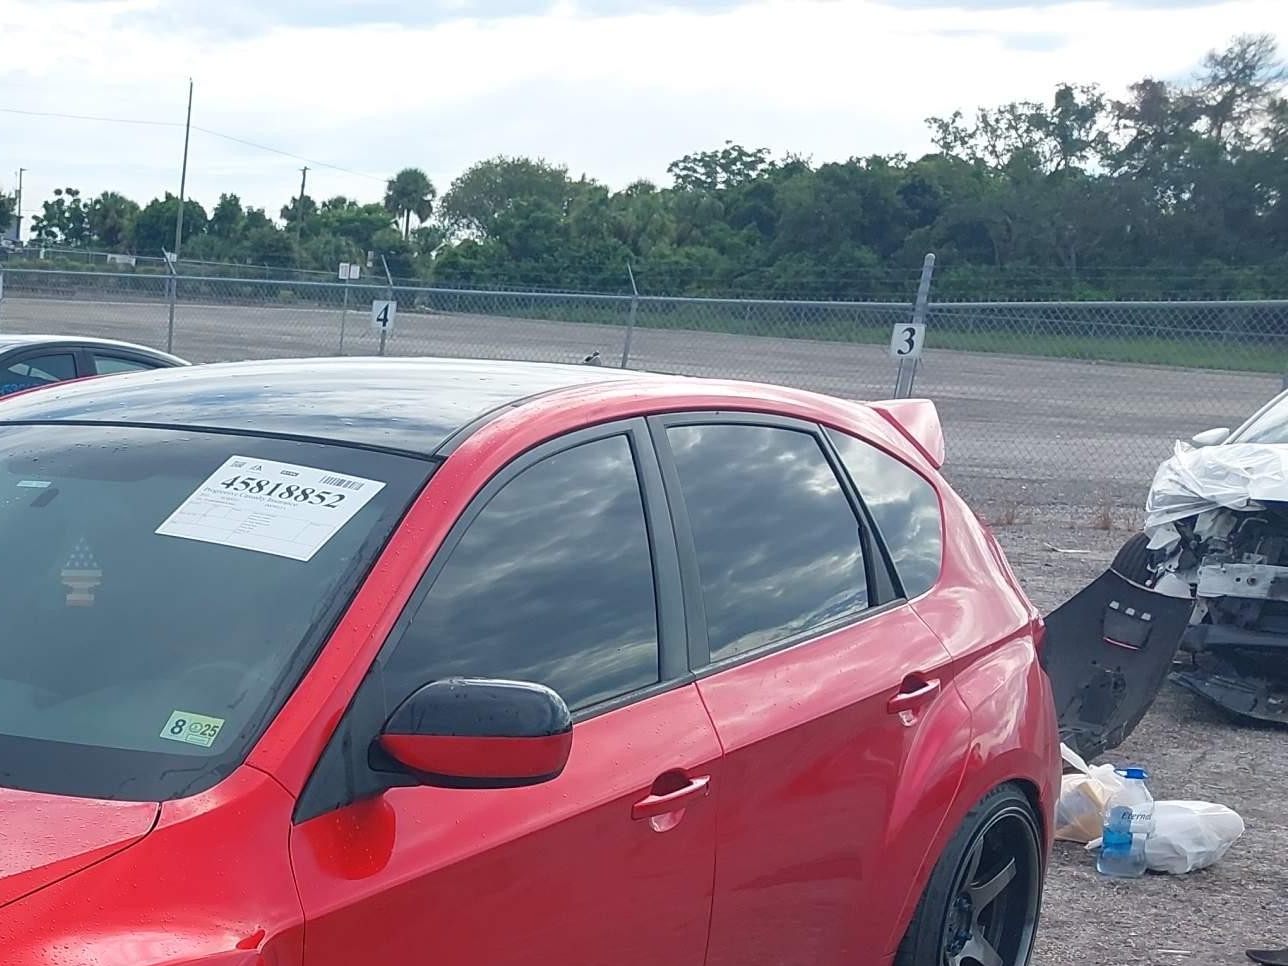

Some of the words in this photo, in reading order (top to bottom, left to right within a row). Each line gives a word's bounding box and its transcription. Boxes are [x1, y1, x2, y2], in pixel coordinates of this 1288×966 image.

[376, 303, 389, 328] 4
[897, 327, 916, 355] 3
[221, 475, 346, 509] 45818852
[171, 719, 187, 735] 8
[200, 723, 219, 736] 25
